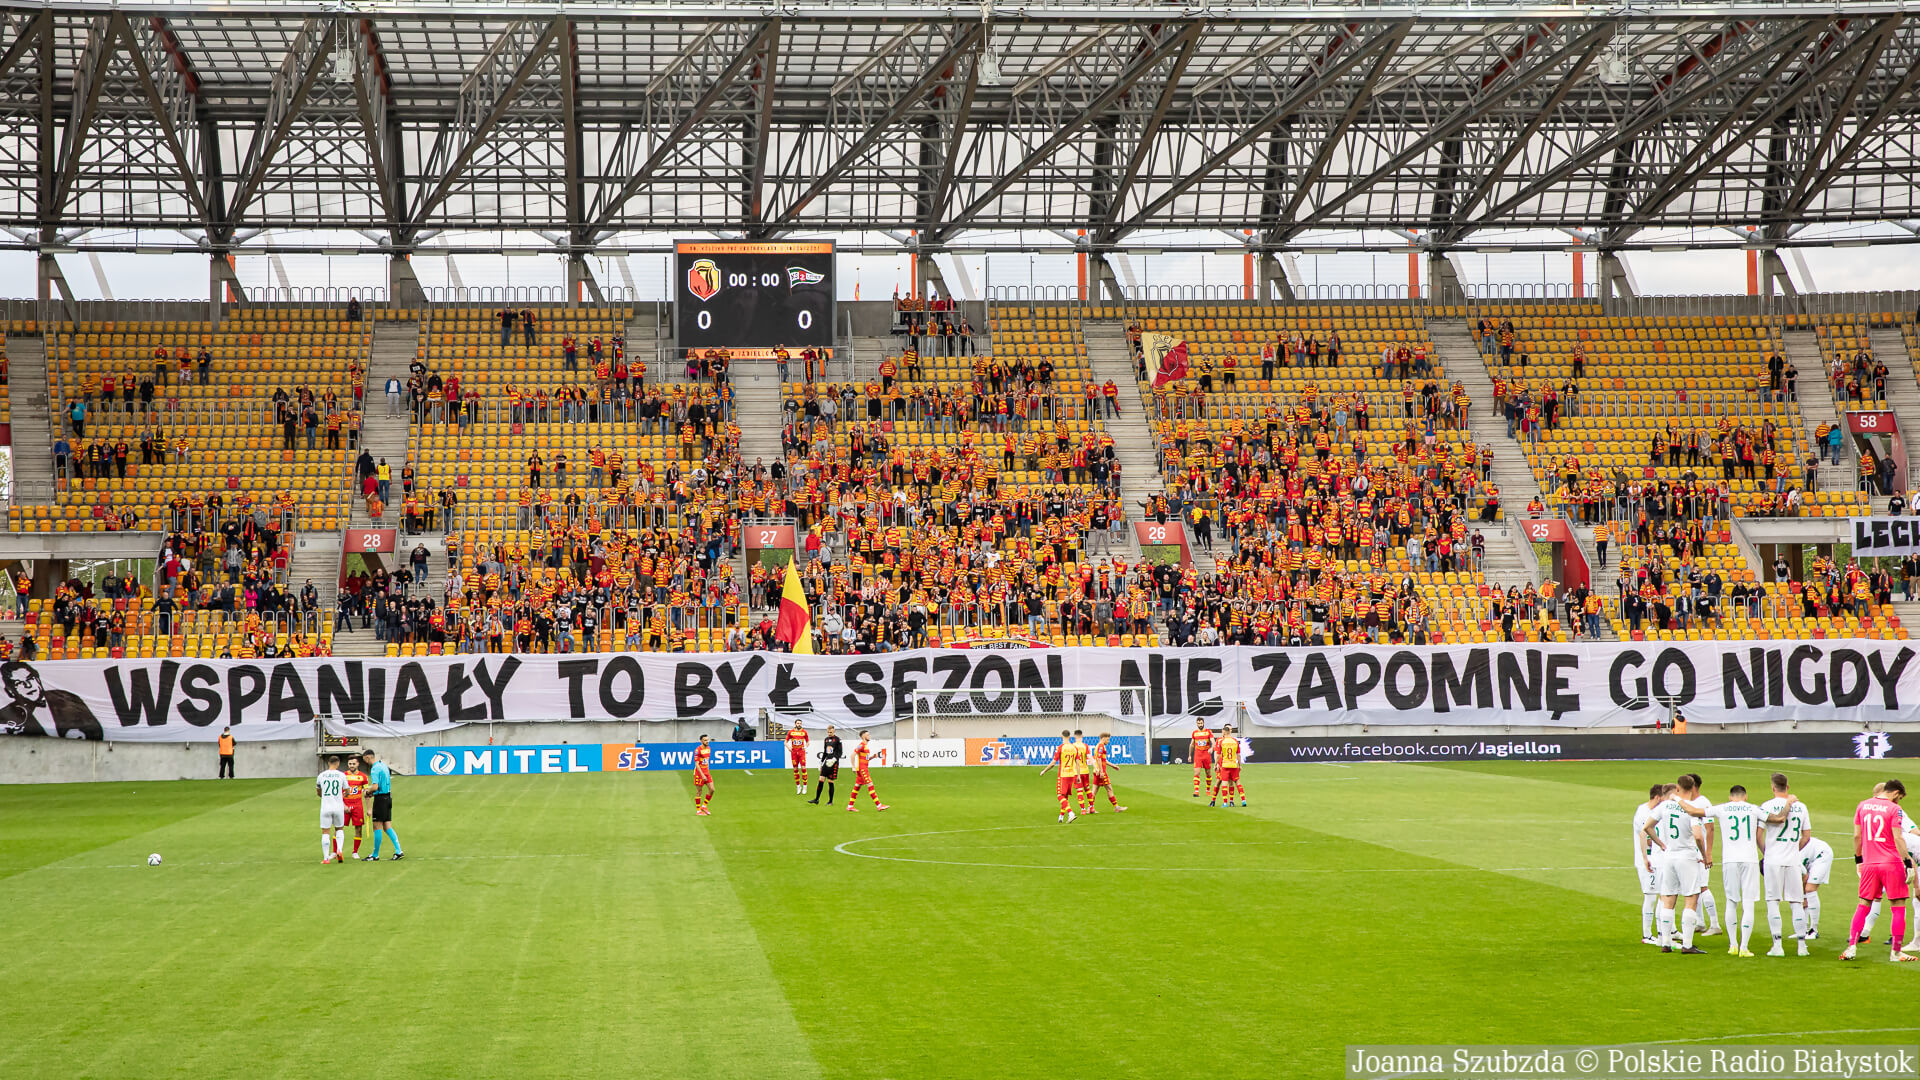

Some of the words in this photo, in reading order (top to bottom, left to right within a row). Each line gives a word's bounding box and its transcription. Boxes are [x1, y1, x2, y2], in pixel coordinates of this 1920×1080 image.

[729, 273, 747, 287] 00
[761, 273, 779, 287] 00
[697, 310, 712, 329] 0
[798, 310, 812, 329] 0
[1859, 415, 1877, 428] 58
[760, 530, 777, 544] 27
[1148, 526, 1166, 540] 26
[1532, 523, 1549, 537] 25
[363, 534, 381, 547] 28
[104, 656, 521, 726] WSPANIAŁY
[558, 656, 645, 718] TO
[675, 655, 812, 717] BYŁ
[843, 655, 1087, 718] SEZON,
[1119, 653, 1223, 716] NIE
[1252, 649, 1580, 720] ZAPOMNĘ
[1609, 648, 1697, 708] GO
[1723, 645, 1916, 710] NIGDY
[661, 750, 771, 765] WW.STS.PL
[901, 751, 930, 759] NORD
[933, 750, 958, 758] AUTO
[981, 742, 1011, 762] STS
[1291, 741, 1561, 757] www.facebook.com/Jagiellon
[464, 749, 589, 774] MITEL
[617, 747, 650, 770] STS
[1064, 754, 1076, 768] 21
[324, 779, 340, 796] 28
[1669, 813, 1680, 839] 5
[1728, 814, 1751, 841] 31
[1776, 816, 1801, 842] 23
[1864, 813, 1886, 842] 12
